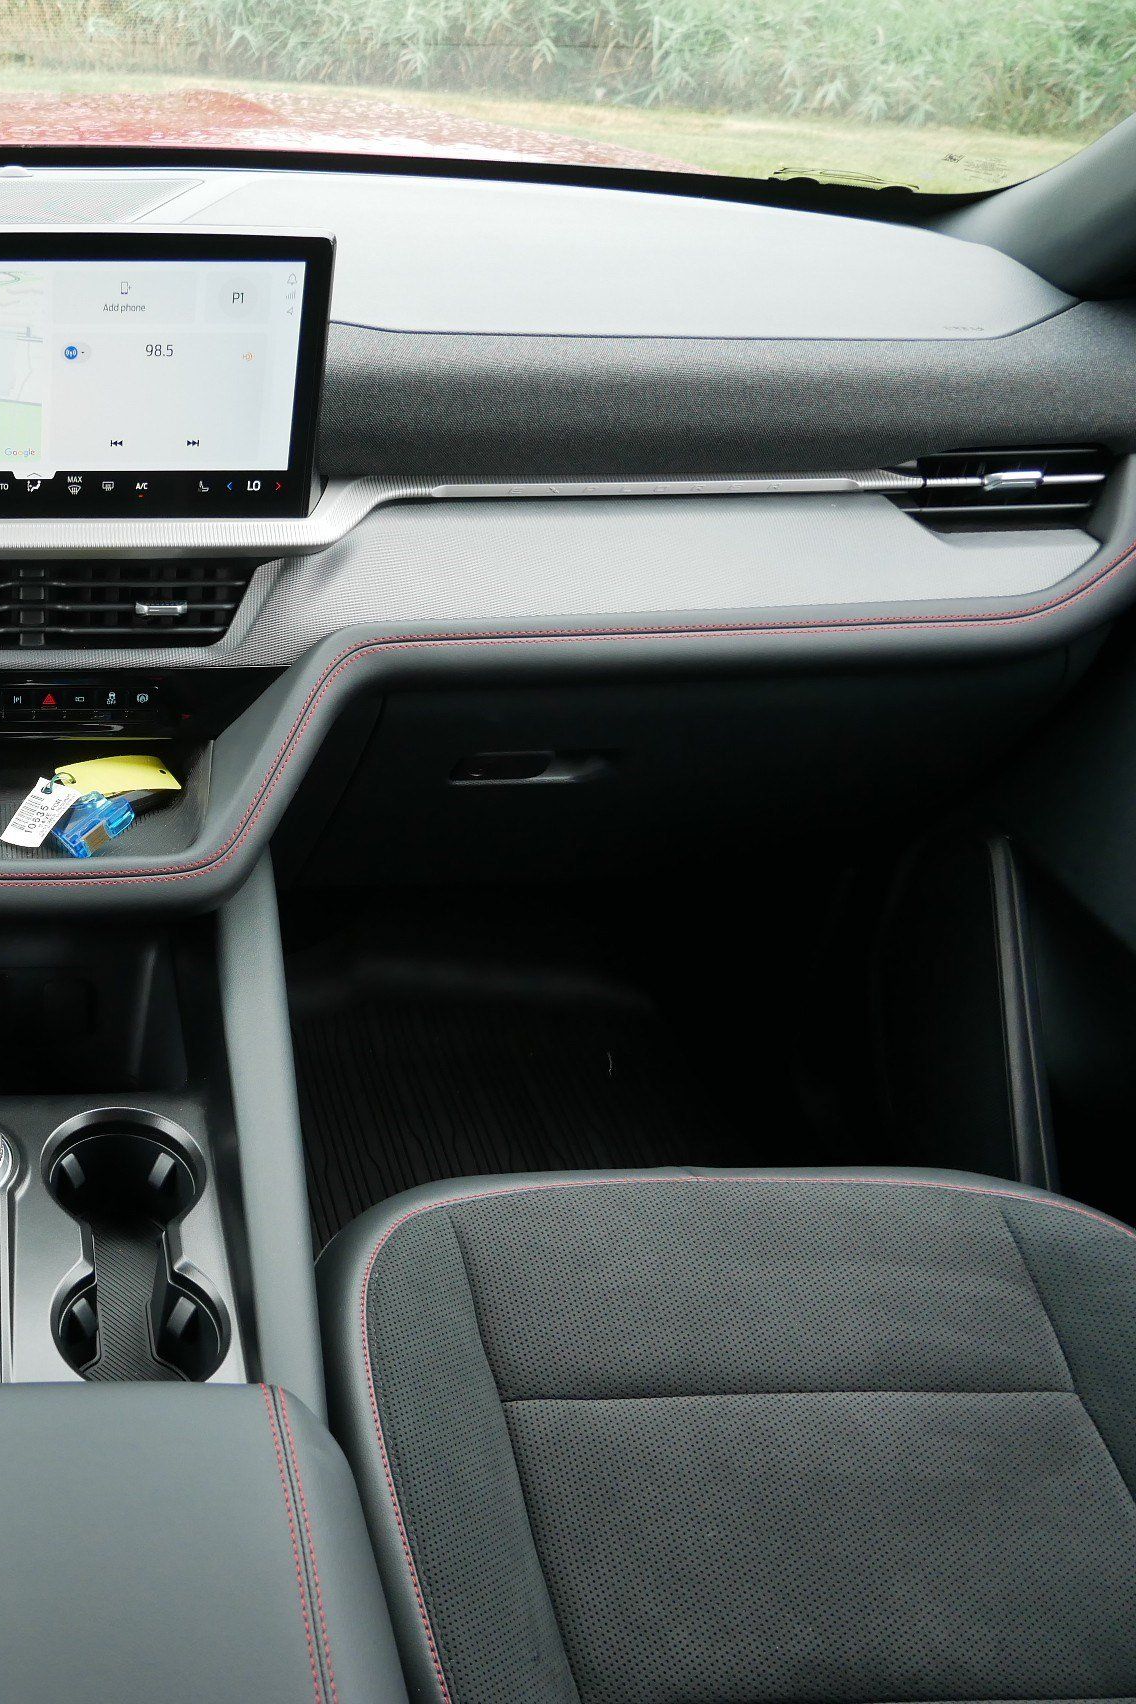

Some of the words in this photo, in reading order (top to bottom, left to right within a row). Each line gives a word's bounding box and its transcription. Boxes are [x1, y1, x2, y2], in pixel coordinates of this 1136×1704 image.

[232, 292, 244, 303] P1
[103, 303, 119, 312] Add
[120, 303, 146, 314] phone
[145, 344, 174, 357] 98.5
[4, 447, 36, 457] Google
[67, 475, 83, 483] MAX
[135, 482, 149, 490] A/C
[246, 480, 261, 491] LO
